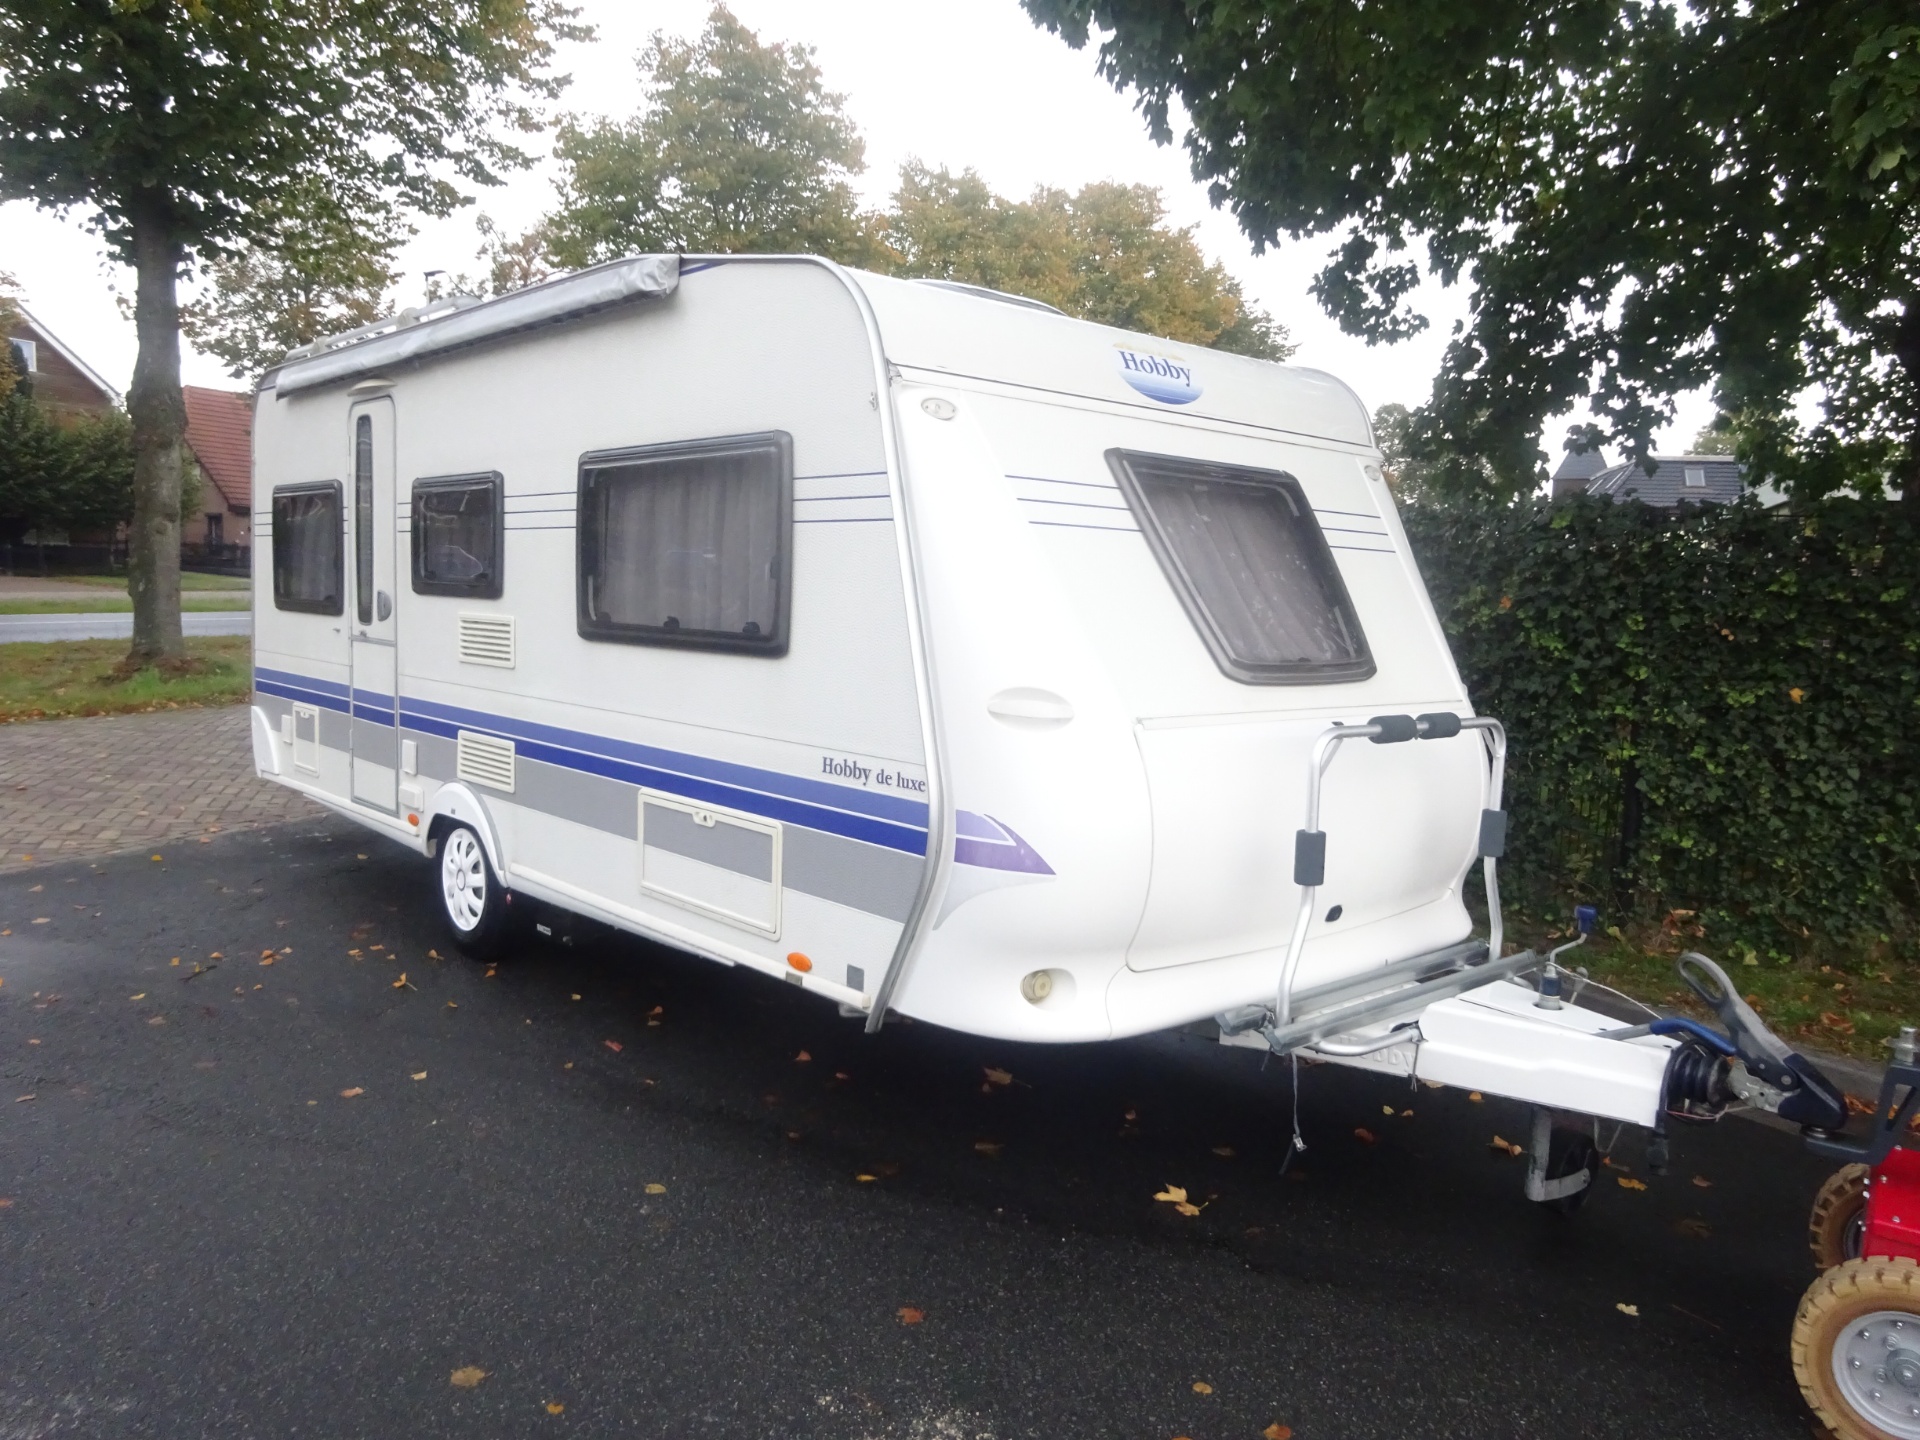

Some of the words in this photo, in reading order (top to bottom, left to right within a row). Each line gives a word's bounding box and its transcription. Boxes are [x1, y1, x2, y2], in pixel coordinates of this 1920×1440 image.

[1118, 350, 1191, 388] Hobby
[821, 756, 872, 787] Hobby
[876, 768, 892, 786] de
[896, 771, 926, 793] luxe
